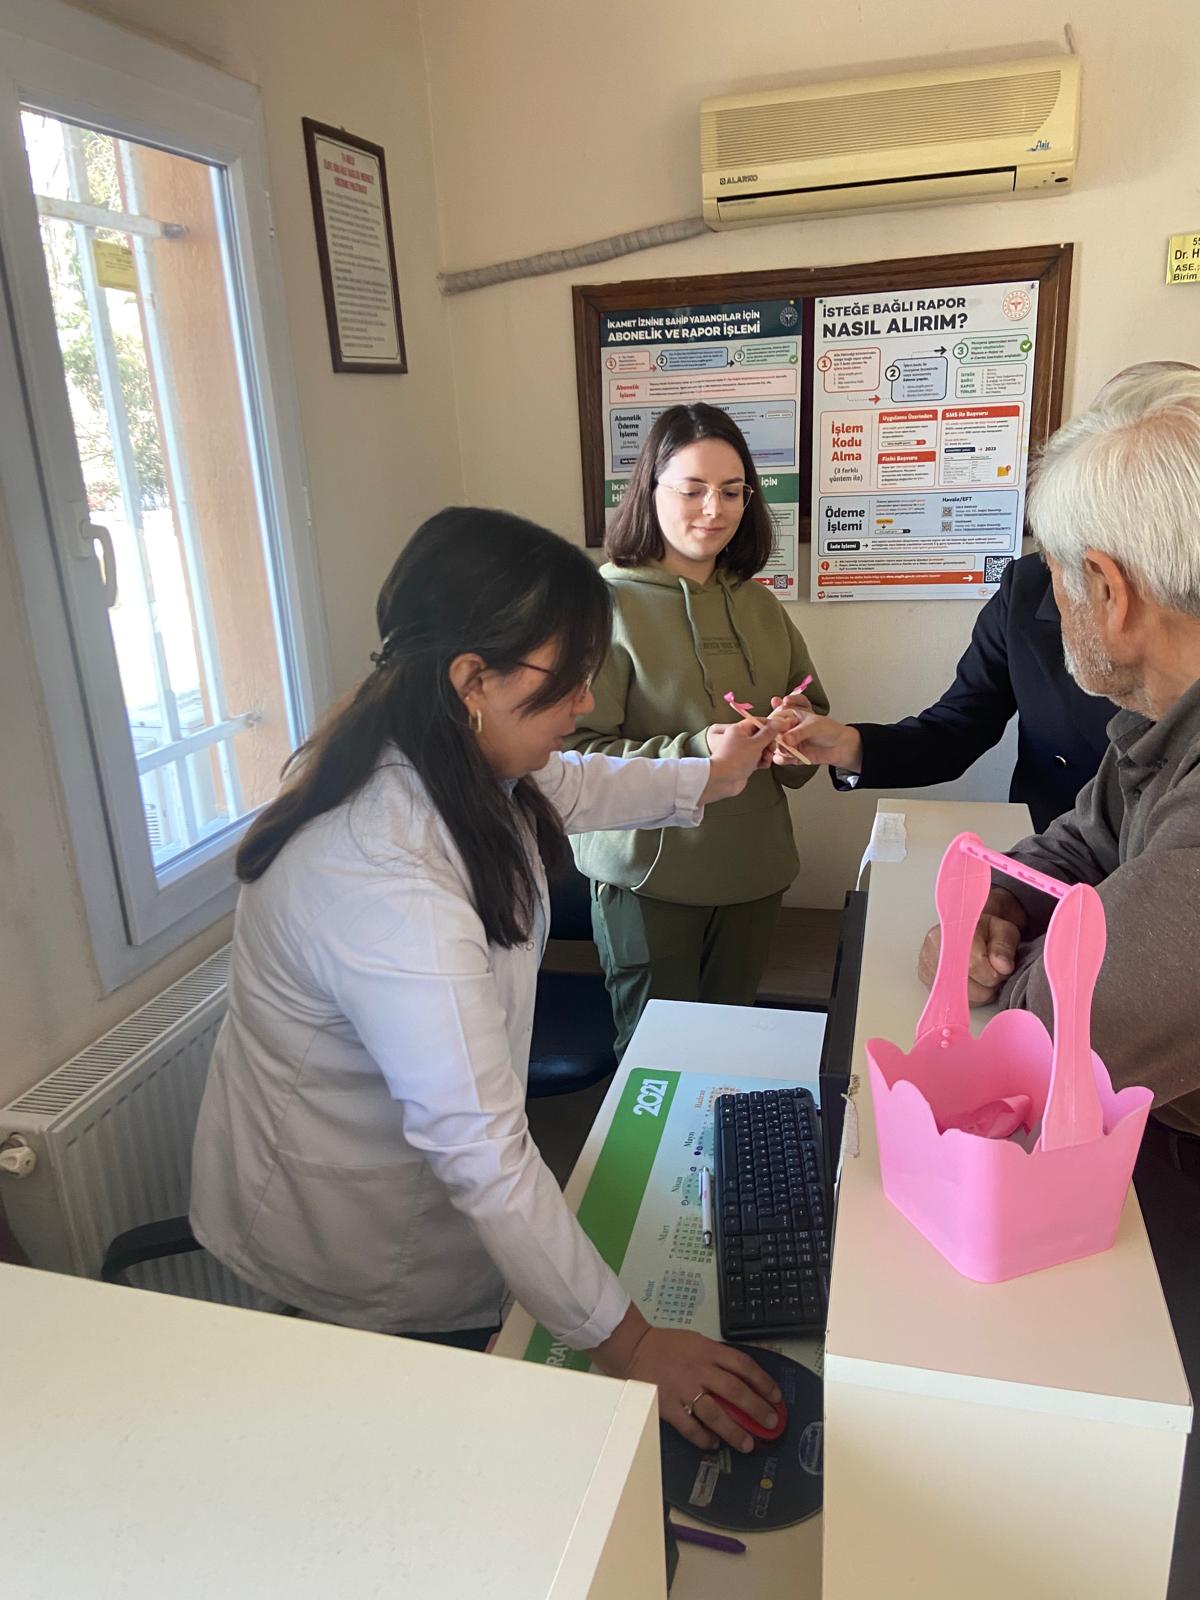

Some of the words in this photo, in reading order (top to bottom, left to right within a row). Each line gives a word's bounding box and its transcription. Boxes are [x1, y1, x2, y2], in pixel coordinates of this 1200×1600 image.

[1175, 249, 1189, 260] Dr.
[1173, 273, 1198, 281] Birim
[823, 302, 869, 318] İSTEĞE
[872, 299, 913, 314] BAĞLI
[916, 297, 966, 311] RAPOR
[607, 318, 637, 329] İKAMET
[637, 316, 664, 327] İZNİNE
[665, 314, 689, 326] SAHİP
[689, 312, 741, 324] YABANCILAR
[742, 309, 760, 321] İÇİN
[607, 327, 662, 342] ABONELİK
[664, 329, 680, 339] VE
[681, 326, 721, 338] RAPOR
[723, 320, 760, 337] İŞLEMİ
[822, 320, 881, 338] NASIL
[886, 313, 968, 334] ALIRIM?
[957, 347, 964, 356] 3
[889, 369, 896, 377] 2
[618, 422, 639, 430] Ödeme
[831, 421, 863, 436] İşlem
[619, 429, 639, 438] İşlemi
[832, 437, 862, 448] Kodu
[831, 451, 862, 462] Alma
[829, 476, 853, 484] yöntem
[825, 505, 866, 518] Ödeme
[827, 520, 862, 533] İşlemi
[632, 1078, 669, 1117] 2021
